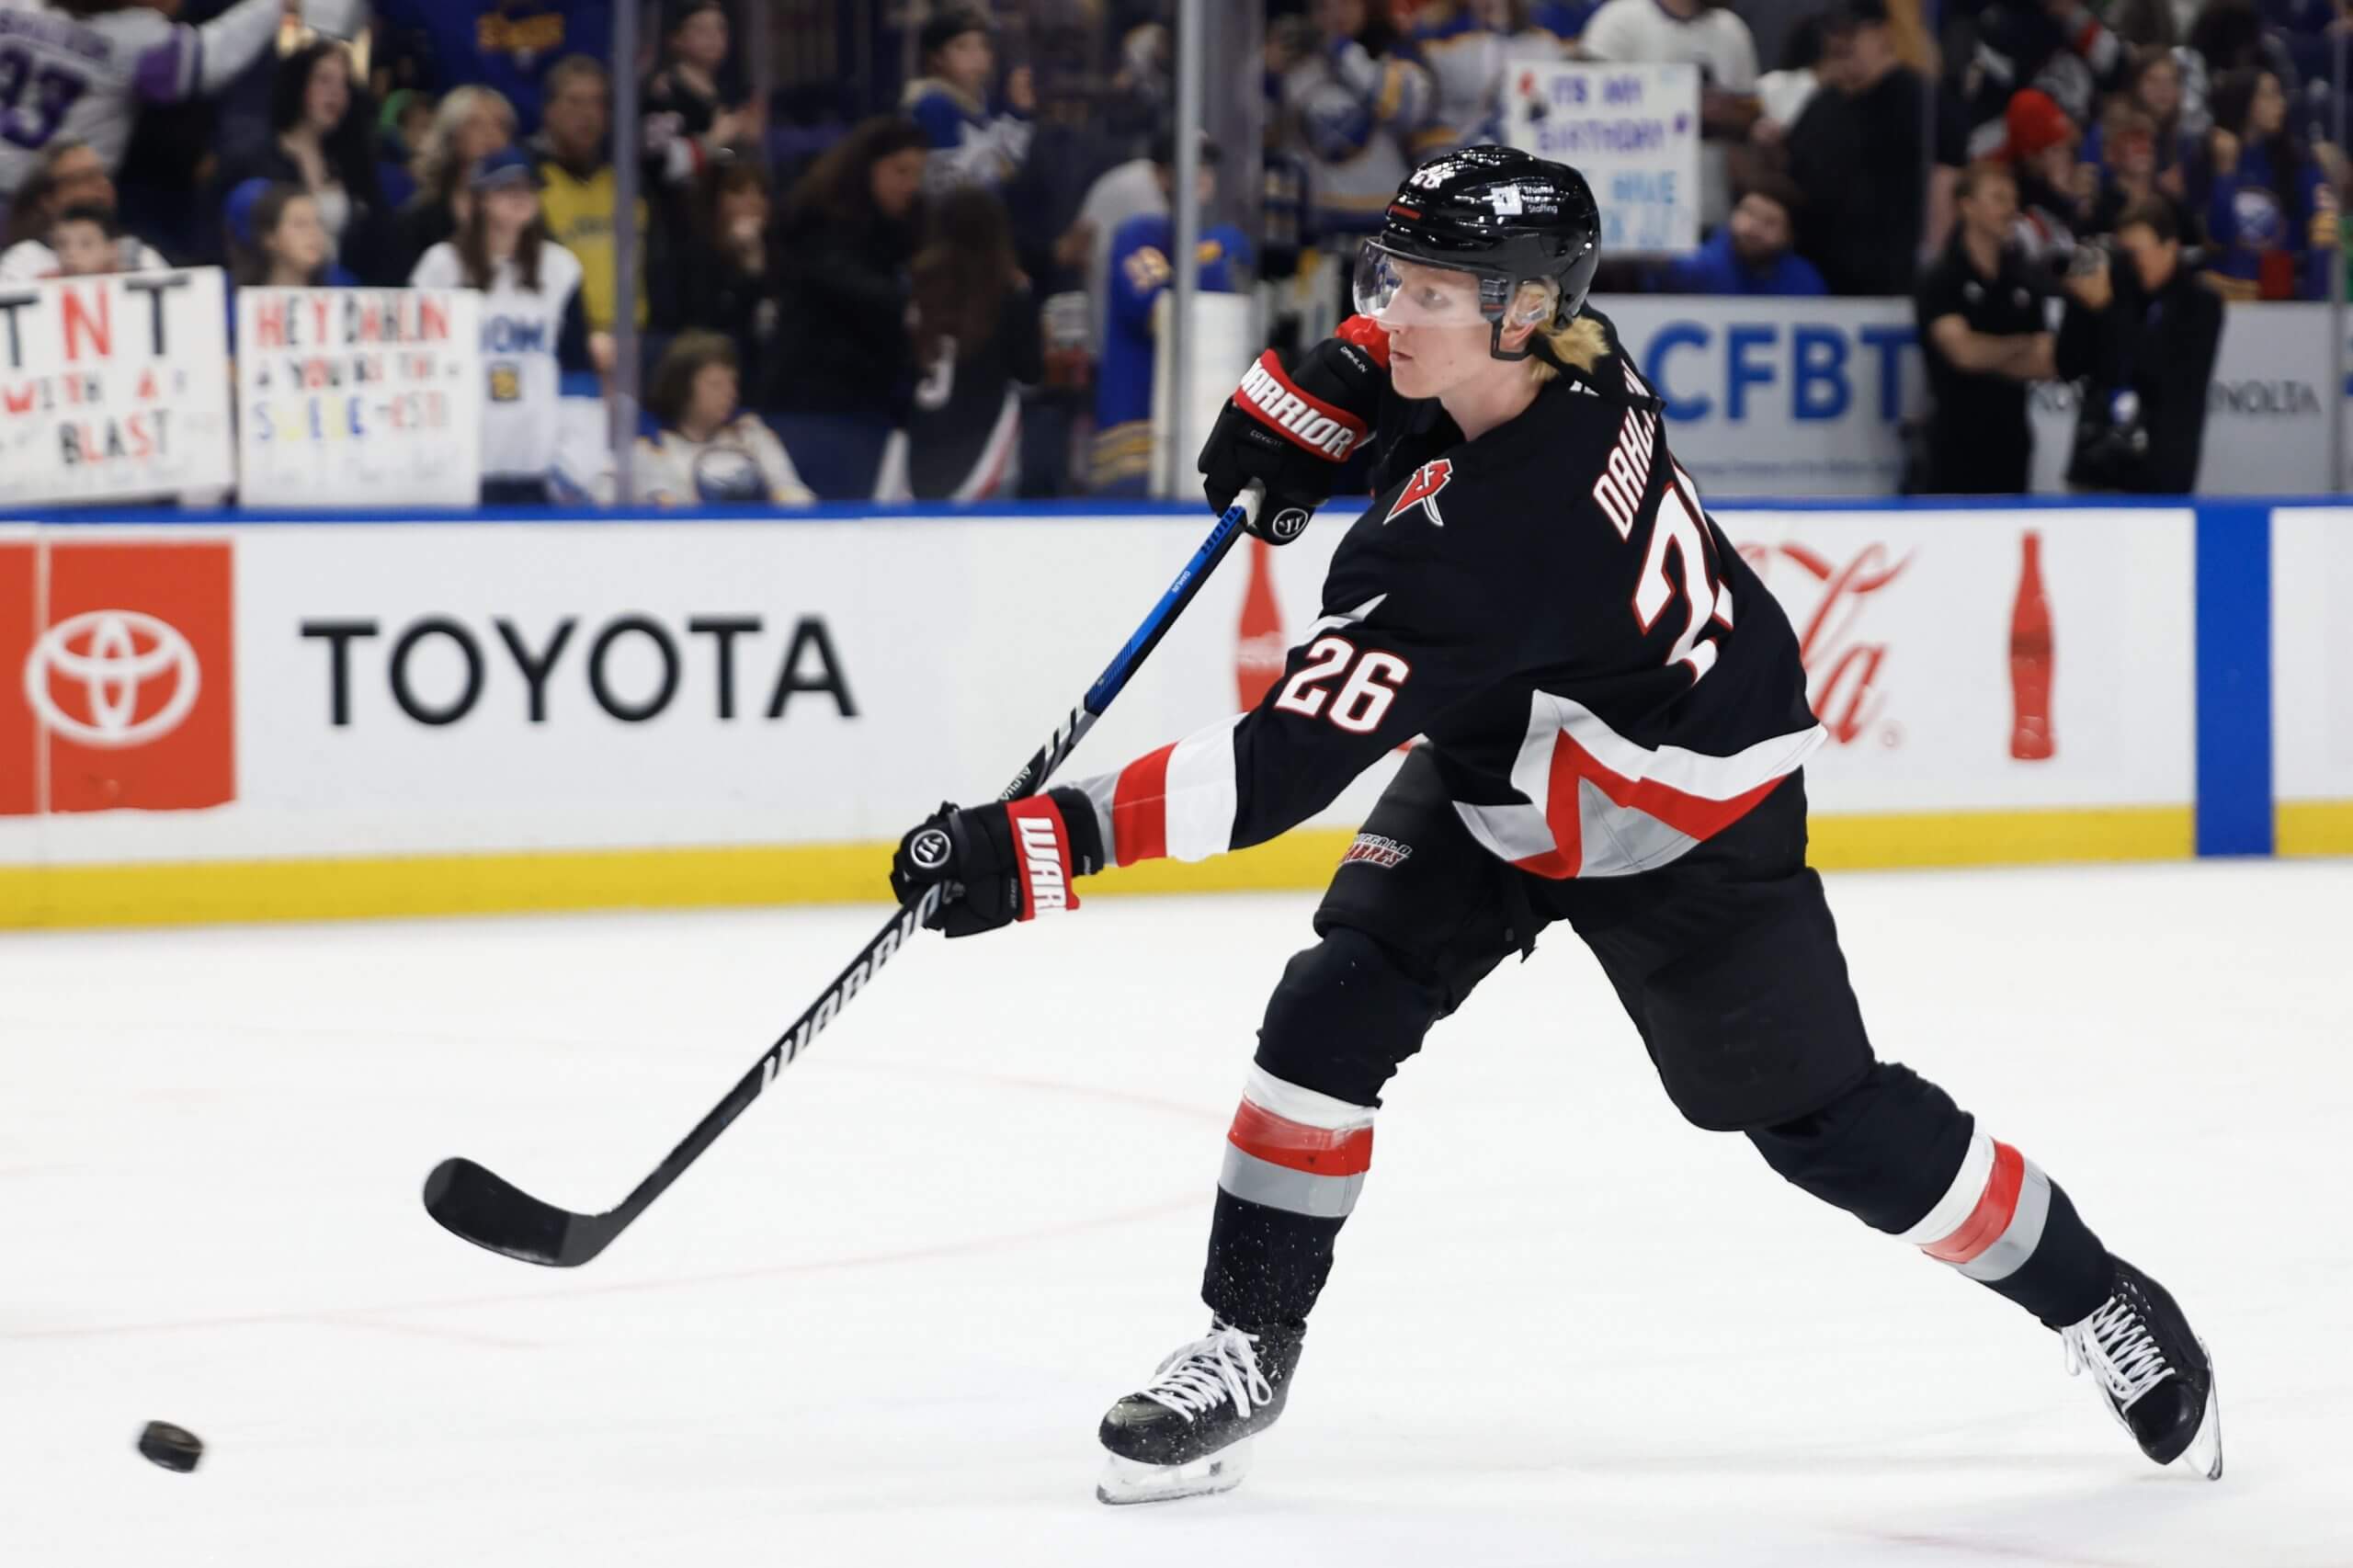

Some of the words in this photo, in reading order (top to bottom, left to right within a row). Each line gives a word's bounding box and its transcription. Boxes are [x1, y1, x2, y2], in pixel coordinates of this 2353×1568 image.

[300, 614, 859, 727] TOYOTA
[1273, 634, 1411, 735] 26
[762, 881, 942, 1094] WARRIO
